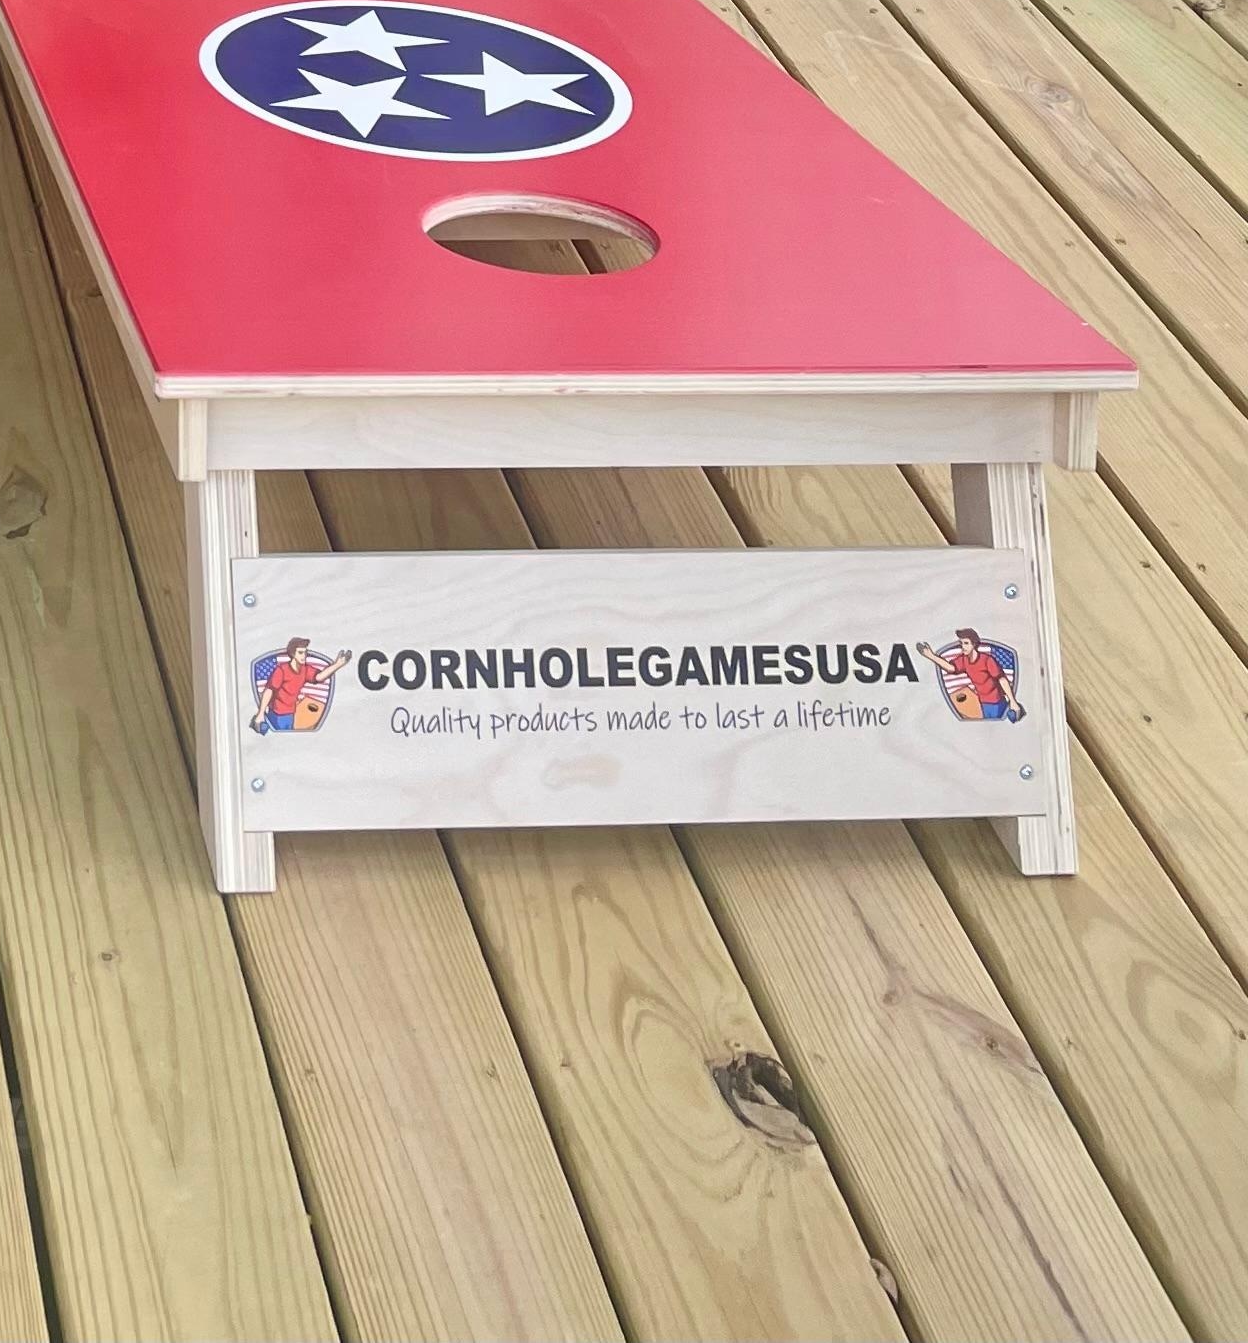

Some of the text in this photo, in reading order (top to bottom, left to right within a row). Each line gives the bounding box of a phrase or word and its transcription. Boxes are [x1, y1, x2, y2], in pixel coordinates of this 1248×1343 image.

[357, 643, 920, 691] CORNHOLEGAMESUSA
[391, 699, 892, 739] Quality products made to last a lifetime
